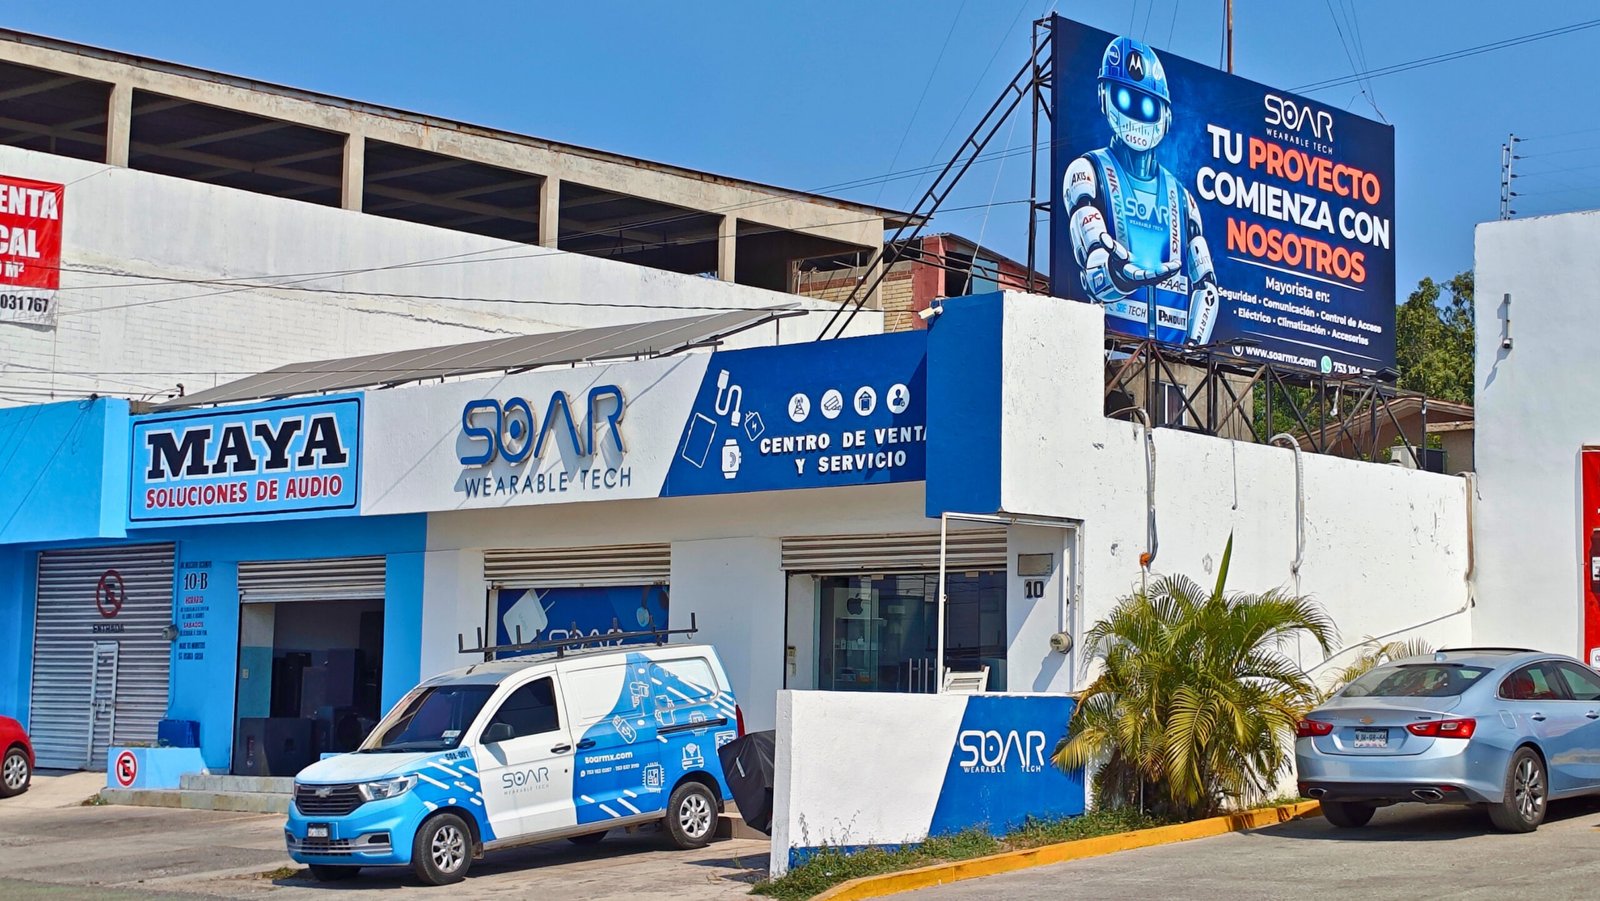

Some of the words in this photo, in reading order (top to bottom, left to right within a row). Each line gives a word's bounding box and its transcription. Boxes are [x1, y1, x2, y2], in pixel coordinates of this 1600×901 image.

[1265, 94, 1334, 143] SOAR
[1125, 134, 1148, 147] CISCO
[1266, 127, 1309, 148] WEARABLE
[1313, 141, 1333, 155] TECH
[1206, 123, 1243, 165] TU
[1249, 137, 1381, 205] PROYECTO
[1071, 171, 1087, 186] AXIS
[1105, 167, 1128, 243] HIKVISION
[1125, 197, 1169, 226] SOAR
[1196, 166, 1335, 234] COMIENZA
[1338, 207, 1390, 250] CON
[1081, 212, 1101, 227] APC
[1227, 217, 1366, 284] NOSOTROS
[1265, 277, 1313, 298] Mayorista
[1315, 290, 1331, 303] en:
[26, 296, 49, 313] 767
[1128, 304, 1147, 318] TECH
[1217, 287, 1257, 305] Seguridad
[1263, 298, 1315, 317] Comunicación
[1320, 311, 1347, 325] Control
[1347, 317, 1357, 328] de
[1357, 320, 1382, 333] Acceso
[1238, 307, 1272, 323] Eléctrico
[1277, 317, 1326, 336] Climatización
[1331, 329, 1369, 346] Accesorios
[1245, 346, 1317, 368] www.soarmx.com
[1333, 361, 1347, 373] 753
[460, 384, 626, 467] SOAR
[145, 413, 349, 482] MAYA
[759, 432, 831, 454] CENTRO
[842, 430, 866, 448] DE
[874, 426, 927, 445] VENT
[795, 458, 806, 475] Y
[817, 449, 907, 473] SERVICIO
[145, 481, 248, 510] SOLUCIONES
[256, 479, 279, 502] DE
[285, 474, 344, 500] AUDIO
[464, 471, 570, 499] WEARABLE
[581, 467, 632, 490] TECH
[1024, 580, 1045, 599] 10
[584, 751, 634, 765] soarmx.com
[959, 730, 1046, 767] SOAR
[502, 766, 550, 789] SOAR
[963, 765, 1006, 773] WEARABLE
[1020, 765, 1041, 773] TECH
